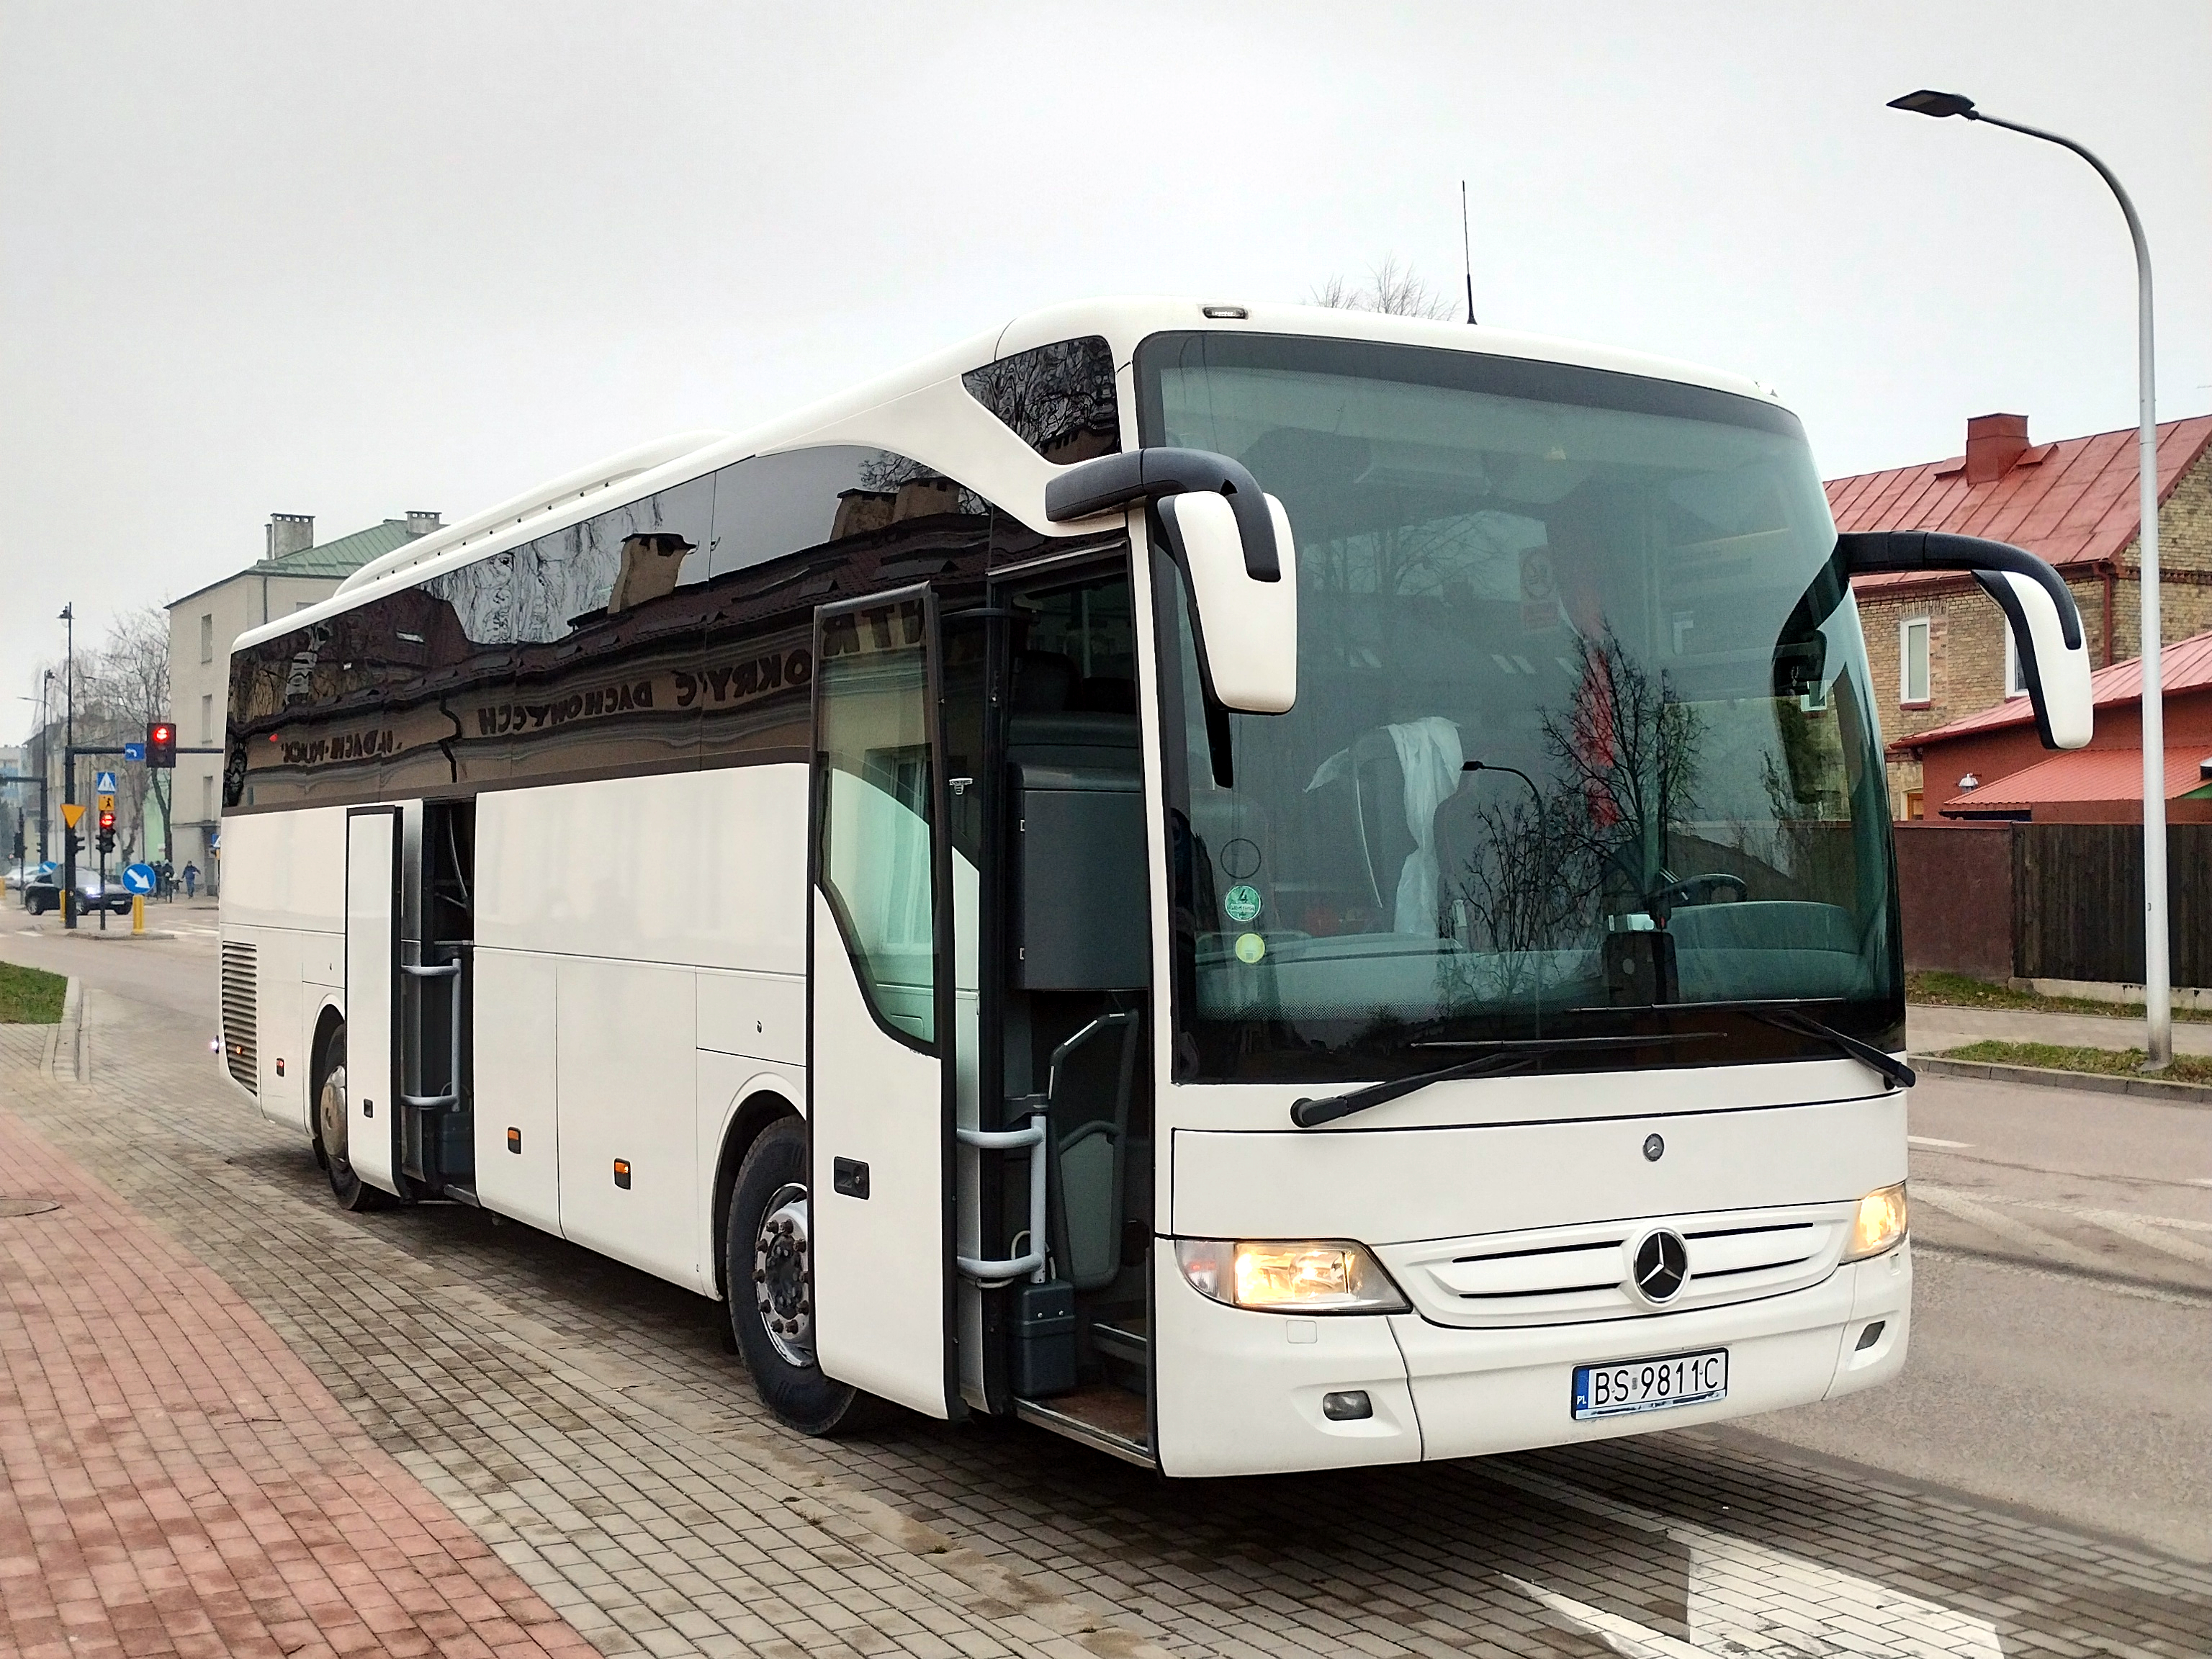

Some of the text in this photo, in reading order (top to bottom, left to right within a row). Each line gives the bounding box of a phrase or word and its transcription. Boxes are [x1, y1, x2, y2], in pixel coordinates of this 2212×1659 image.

[1594, 1358, 1719, 1406] BS 9811C
[1577, 1395, 1588, 1405] PL
